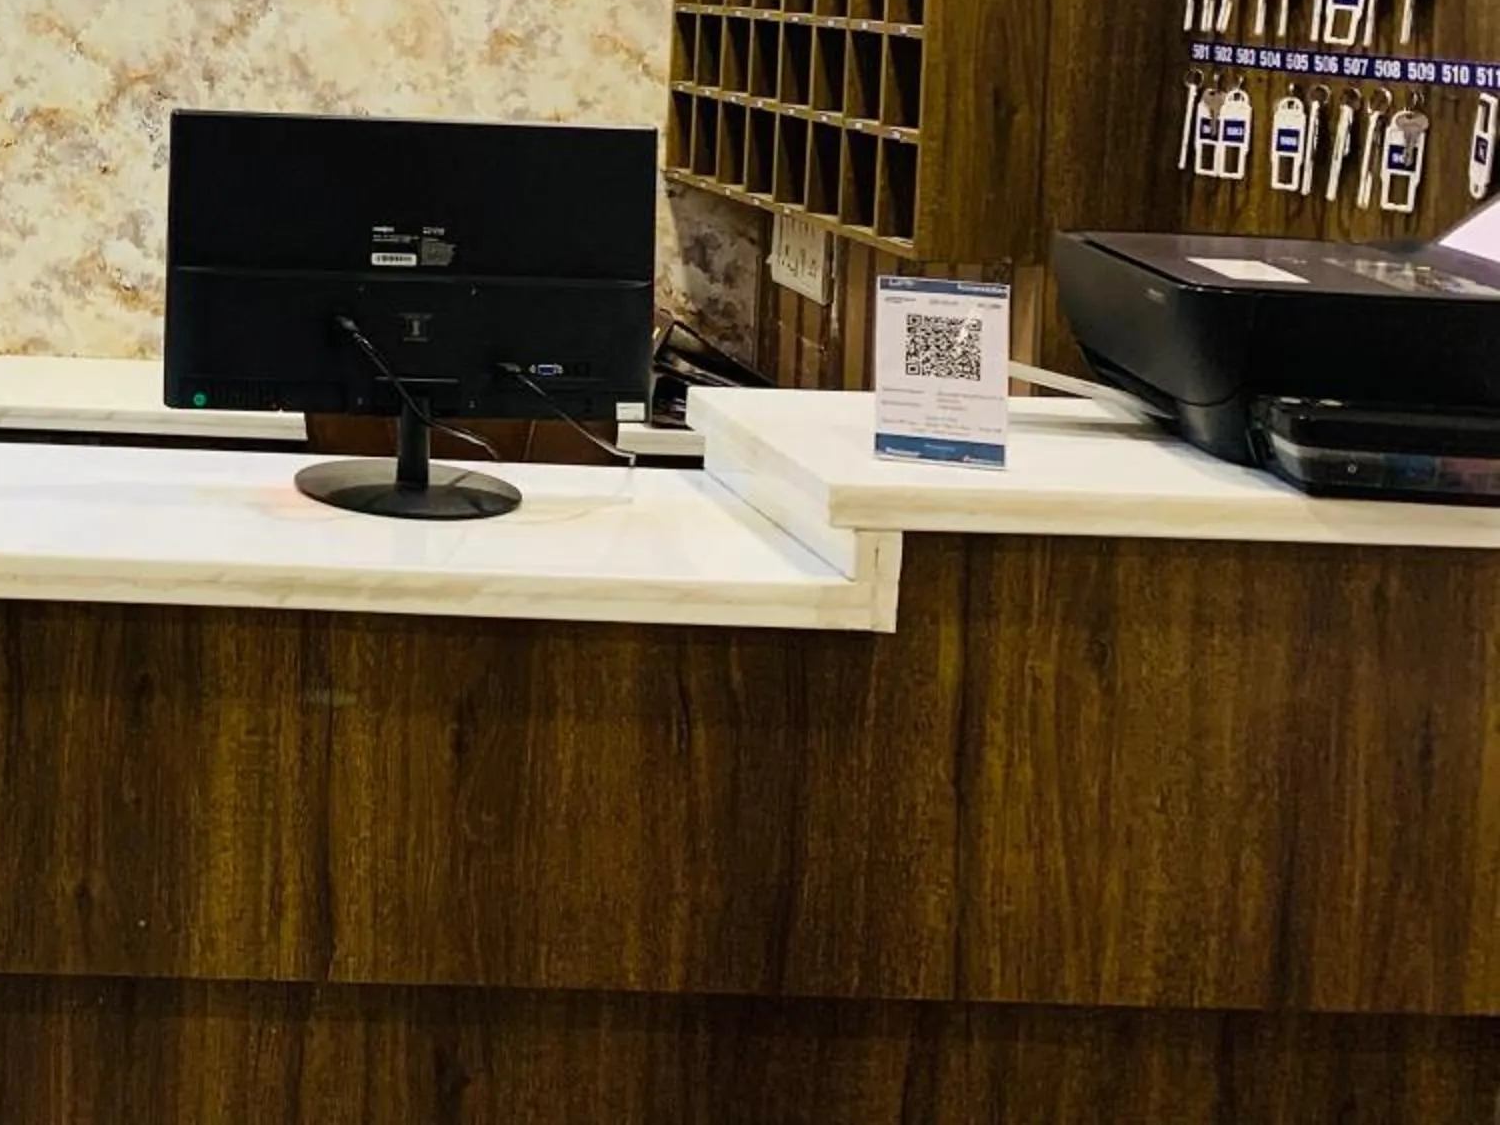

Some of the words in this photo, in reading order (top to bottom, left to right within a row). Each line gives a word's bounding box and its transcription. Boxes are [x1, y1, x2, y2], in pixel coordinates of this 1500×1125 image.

[1236, 47, 1257, 66] 503
[1260, 50, 1281, 68] 504
[1286, 52, 1309, 71] 505
[1314, 54, 1339, 74] 506
[1343, 57, 1368, 76] 507
[1374, 59, 1401, 79] 508
[1407, 61, 1435, 82] 509
[1441, 63, 1470, 85] 510
